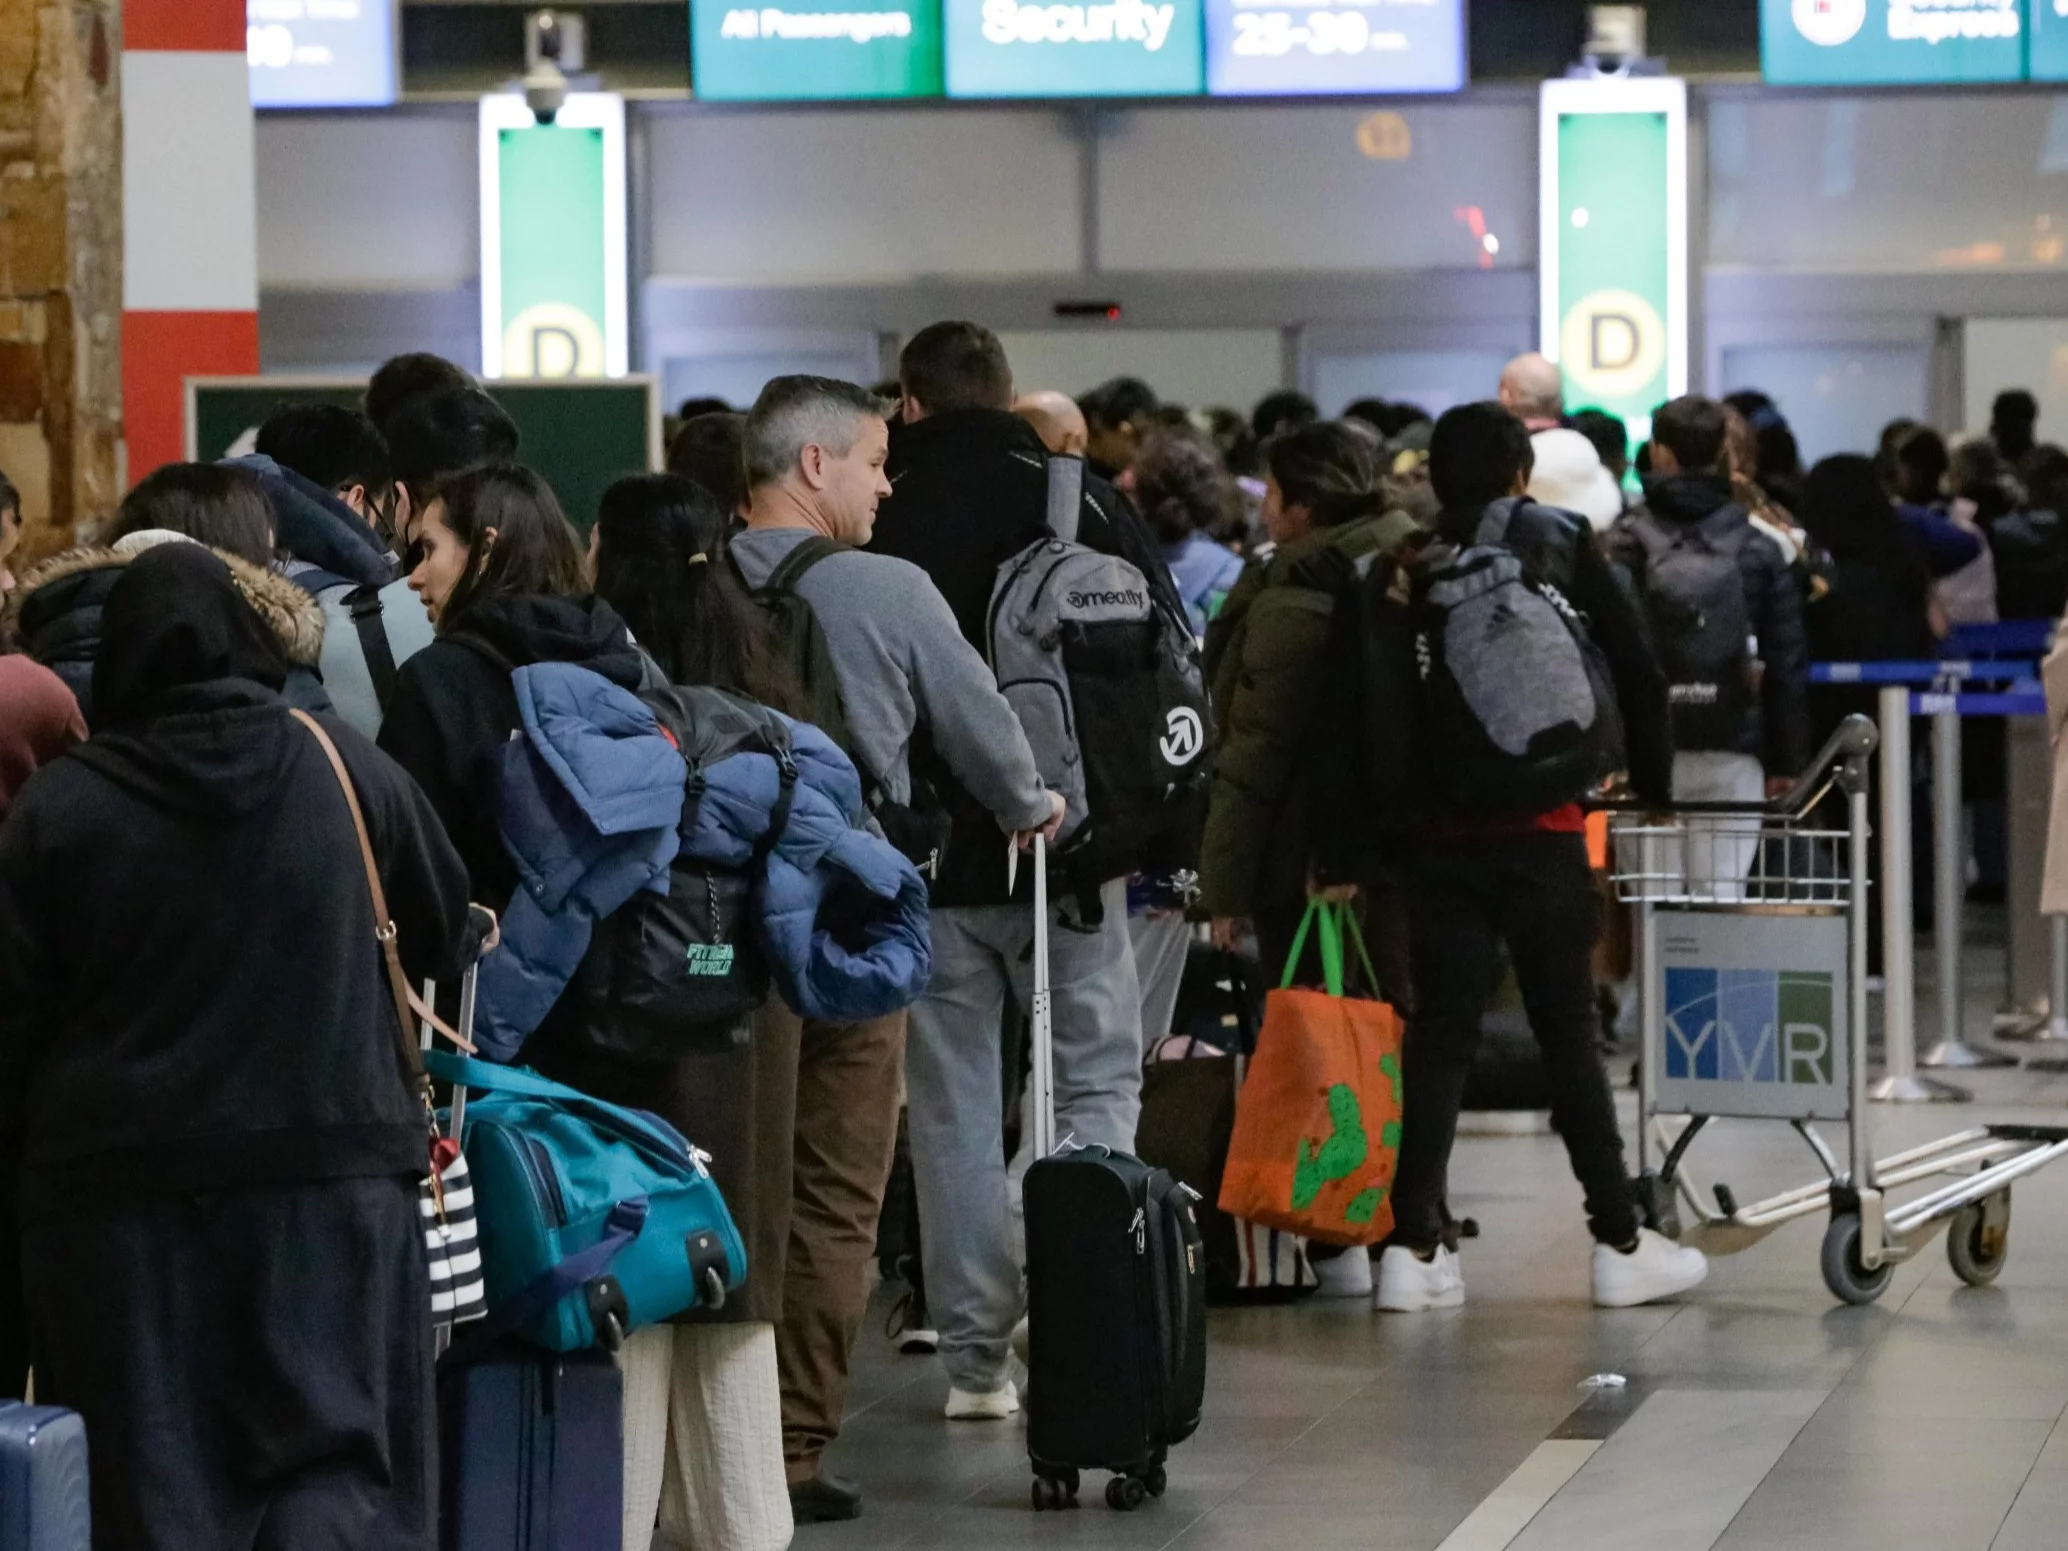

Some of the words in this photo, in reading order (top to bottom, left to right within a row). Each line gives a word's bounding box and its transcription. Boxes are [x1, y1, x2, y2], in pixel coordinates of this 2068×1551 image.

[981, 0, 1175, 51] Security
[531, 326, 580, 377] D
[1590, 313, 1641, 369] D
[689, 959, 732, 975] WORLD
[1666, 1015, 1831, 1086] YVR
